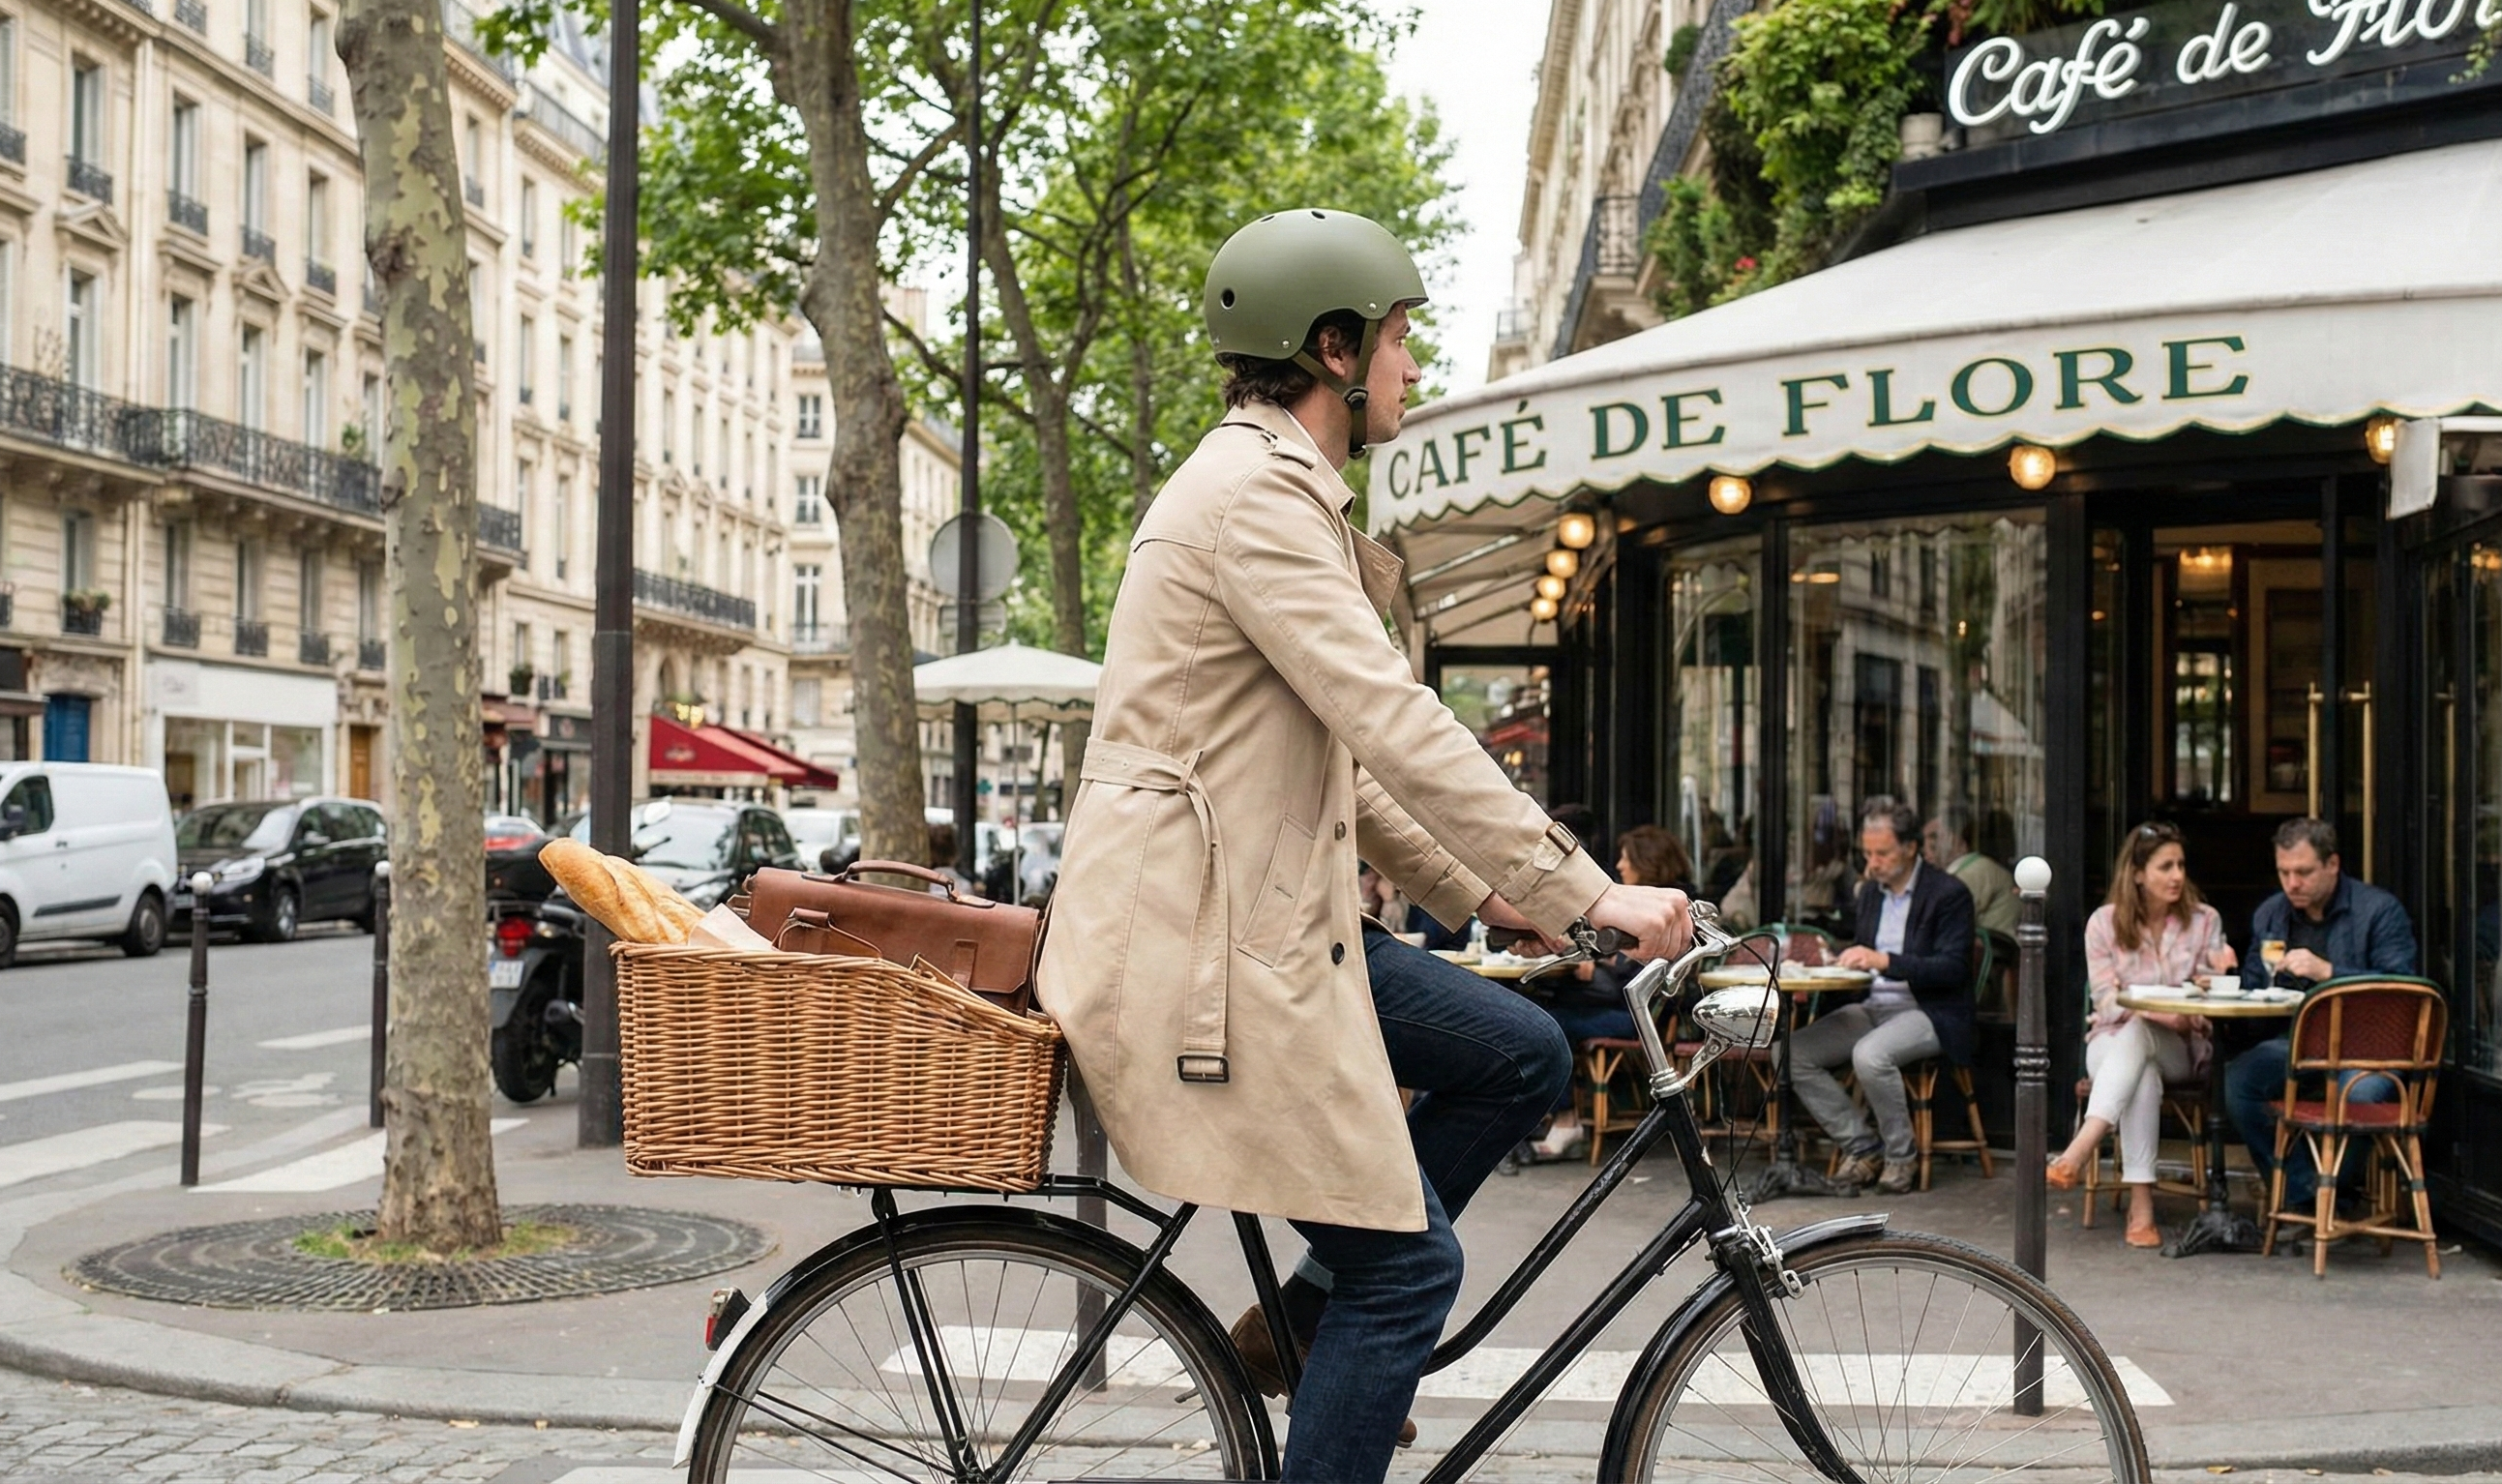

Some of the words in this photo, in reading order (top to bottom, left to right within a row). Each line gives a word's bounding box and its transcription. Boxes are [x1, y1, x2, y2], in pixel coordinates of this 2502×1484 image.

[1948, 16, 2151, 134] Café
[2176, 3, 2273, 84] de
[1387, 400, 1548, 500] CAFÉ
[1589, 389, 1726, 460] DE
[1780, 336, 2249, 437] FLORE
